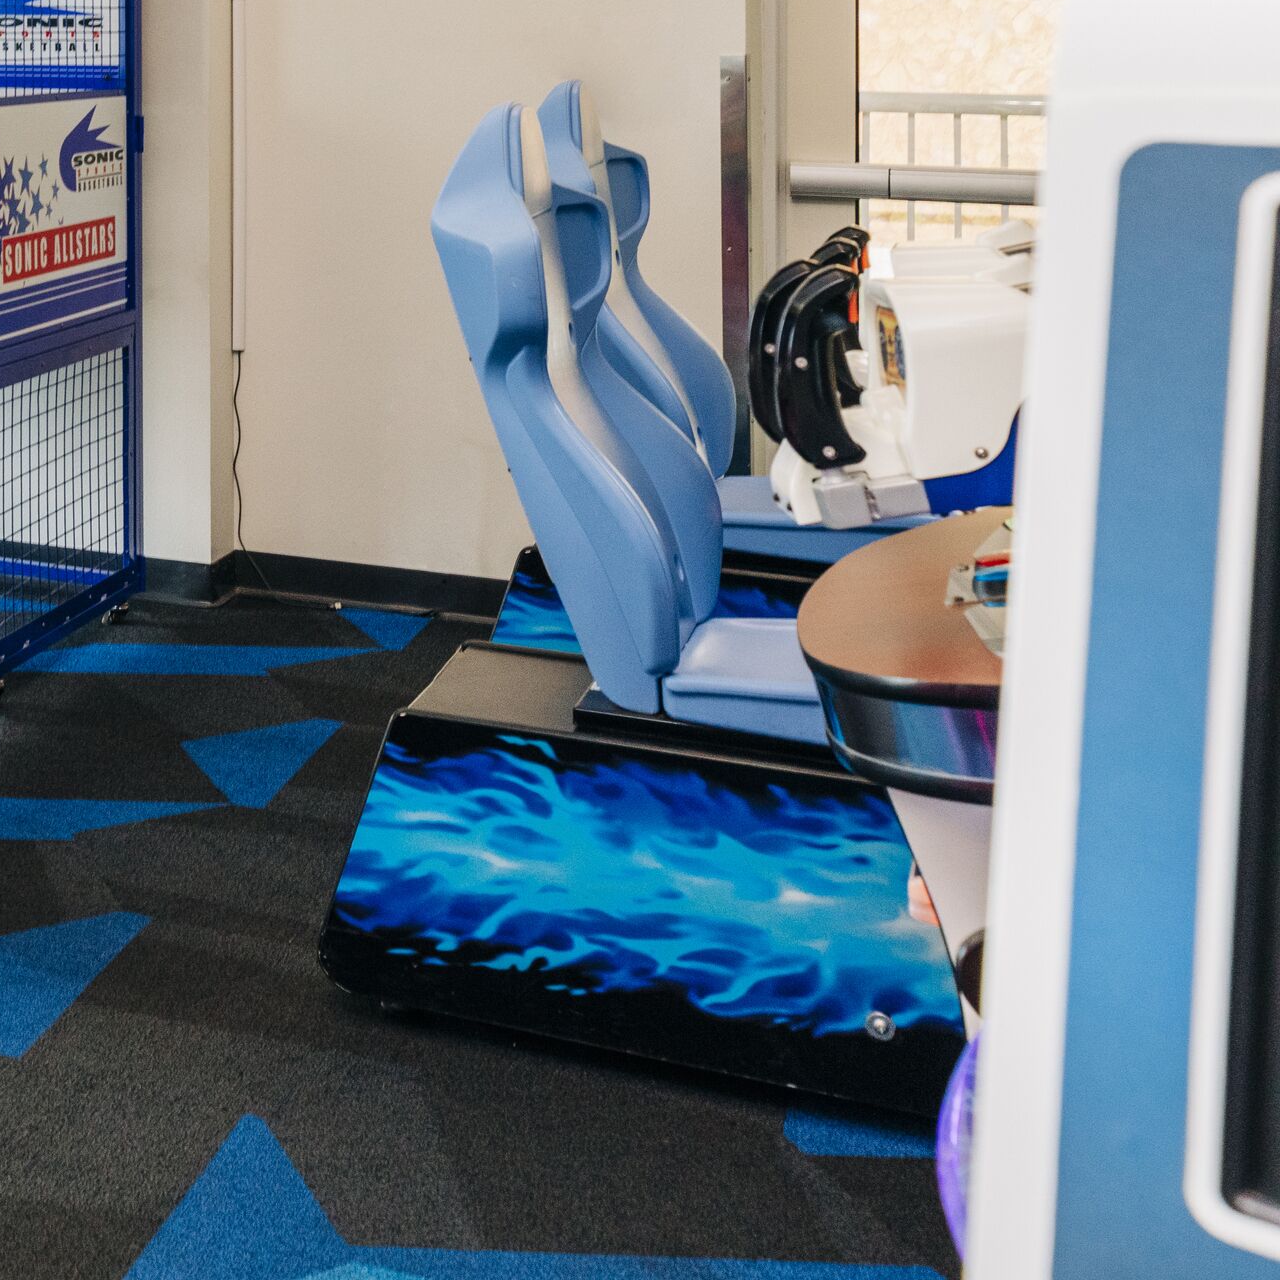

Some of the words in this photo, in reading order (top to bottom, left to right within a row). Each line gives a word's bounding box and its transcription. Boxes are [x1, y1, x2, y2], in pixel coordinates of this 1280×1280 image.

[73, 149, 124, 167] SONIC
[4, 240, 49, 277] SONIC
[54, 222, 115, 266] ALLSTARS
